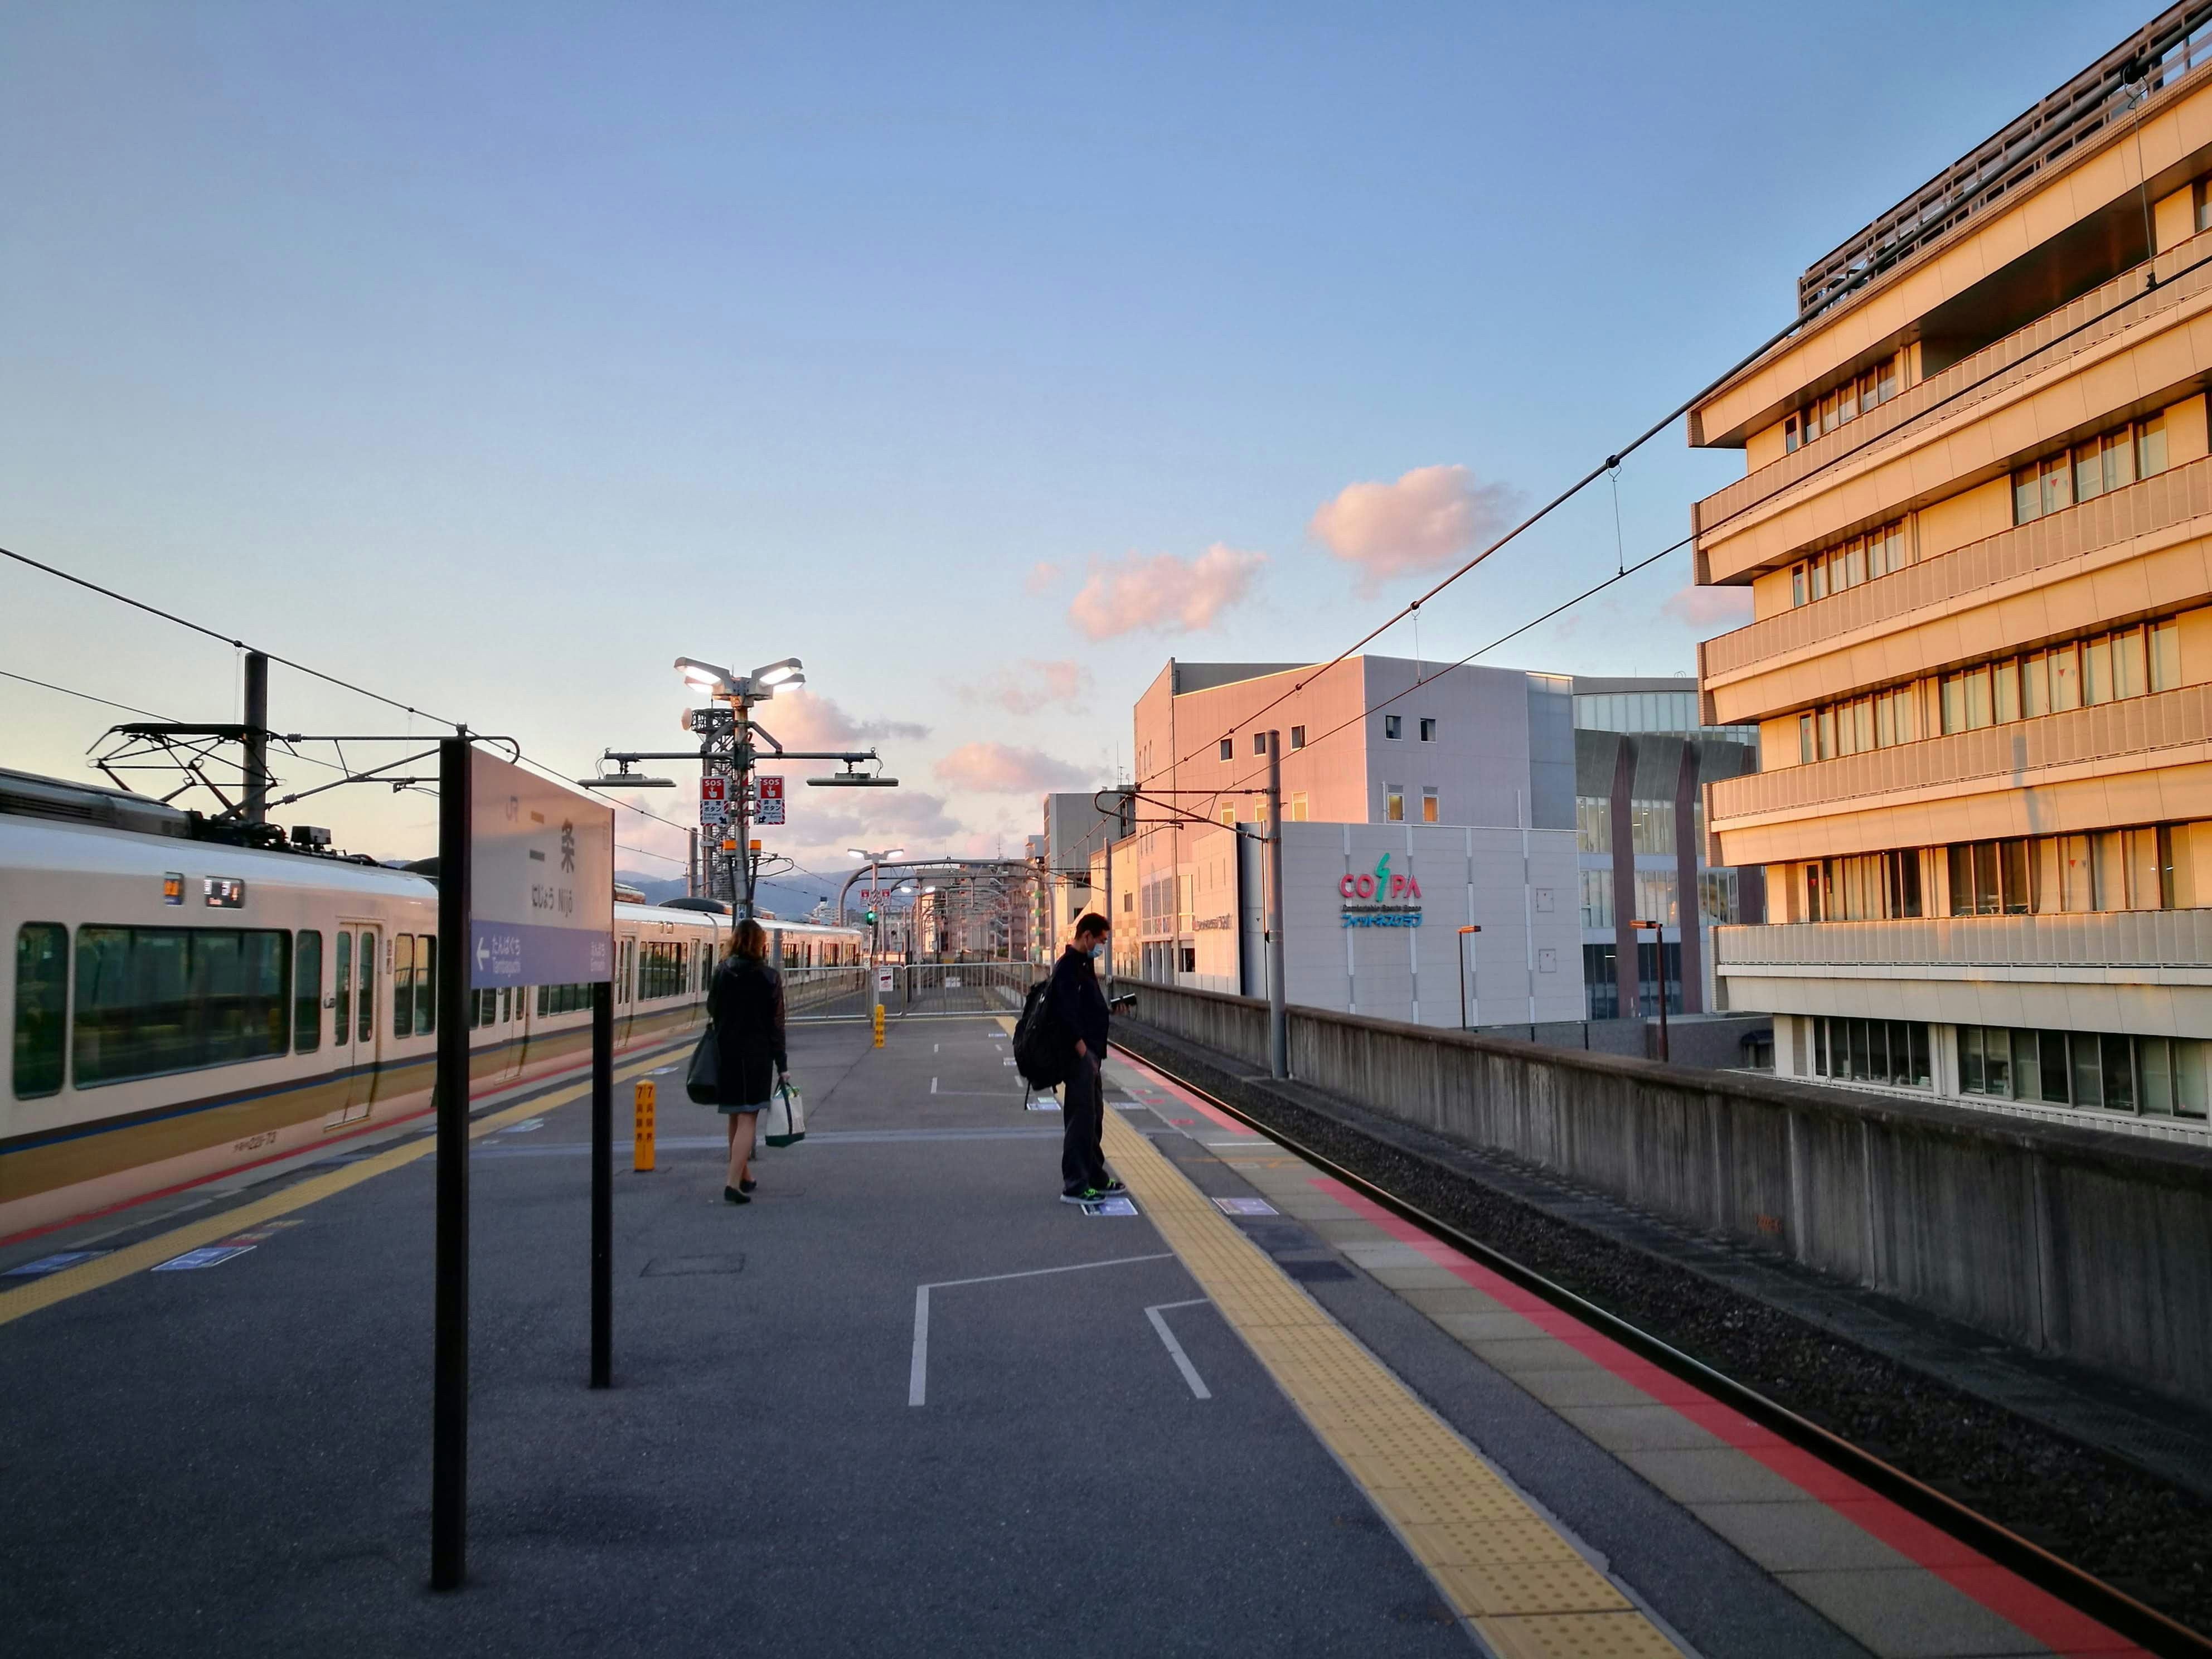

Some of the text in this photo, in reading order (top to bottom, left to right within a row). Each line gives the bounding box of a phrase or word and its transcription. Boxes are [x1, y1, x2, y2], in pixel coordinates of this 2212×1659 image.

[530, 811, 575, 874] 二条
[532, 884, 554, 910] にじょう
[1341, 914, 1423, 928] フィットネスクラブ
